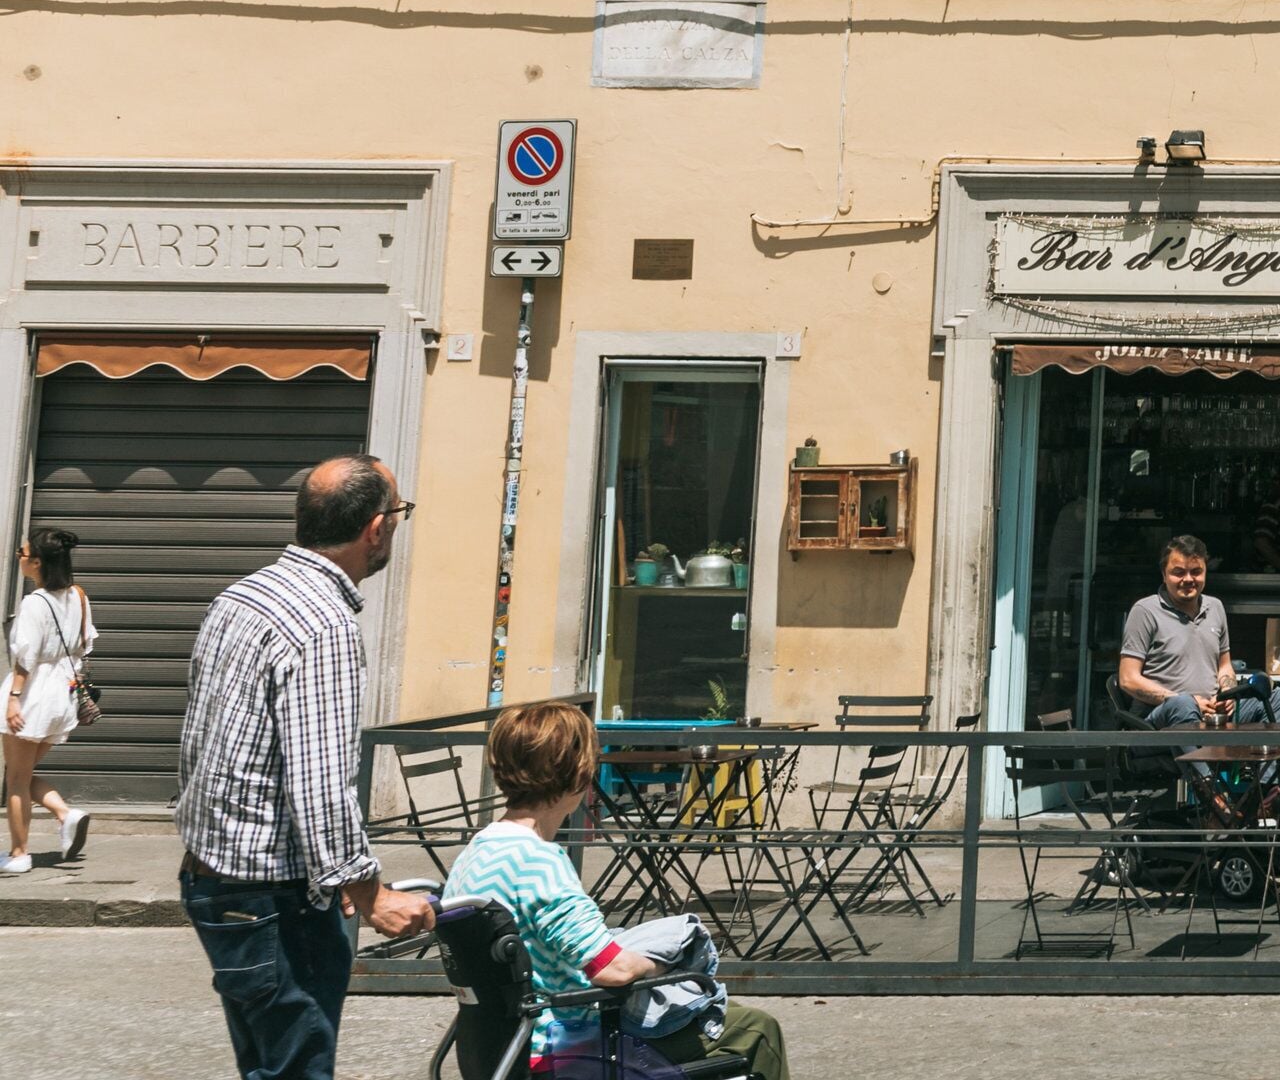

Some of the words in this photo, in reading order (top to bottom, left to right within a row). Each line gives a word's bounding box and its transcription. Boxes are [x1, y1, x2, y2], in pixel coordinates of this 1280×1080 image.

[608, 46, 672, 61] DELLA
[681, 46, 749, 61] CALZA
[543, 189, 560, 199] pari
[81, 222, 342, 268] BARBIERE
[1017, 229, 1111, 271] Bar
[454, 339, 466, 355] 2
[783, 335, 794, 352] 3
